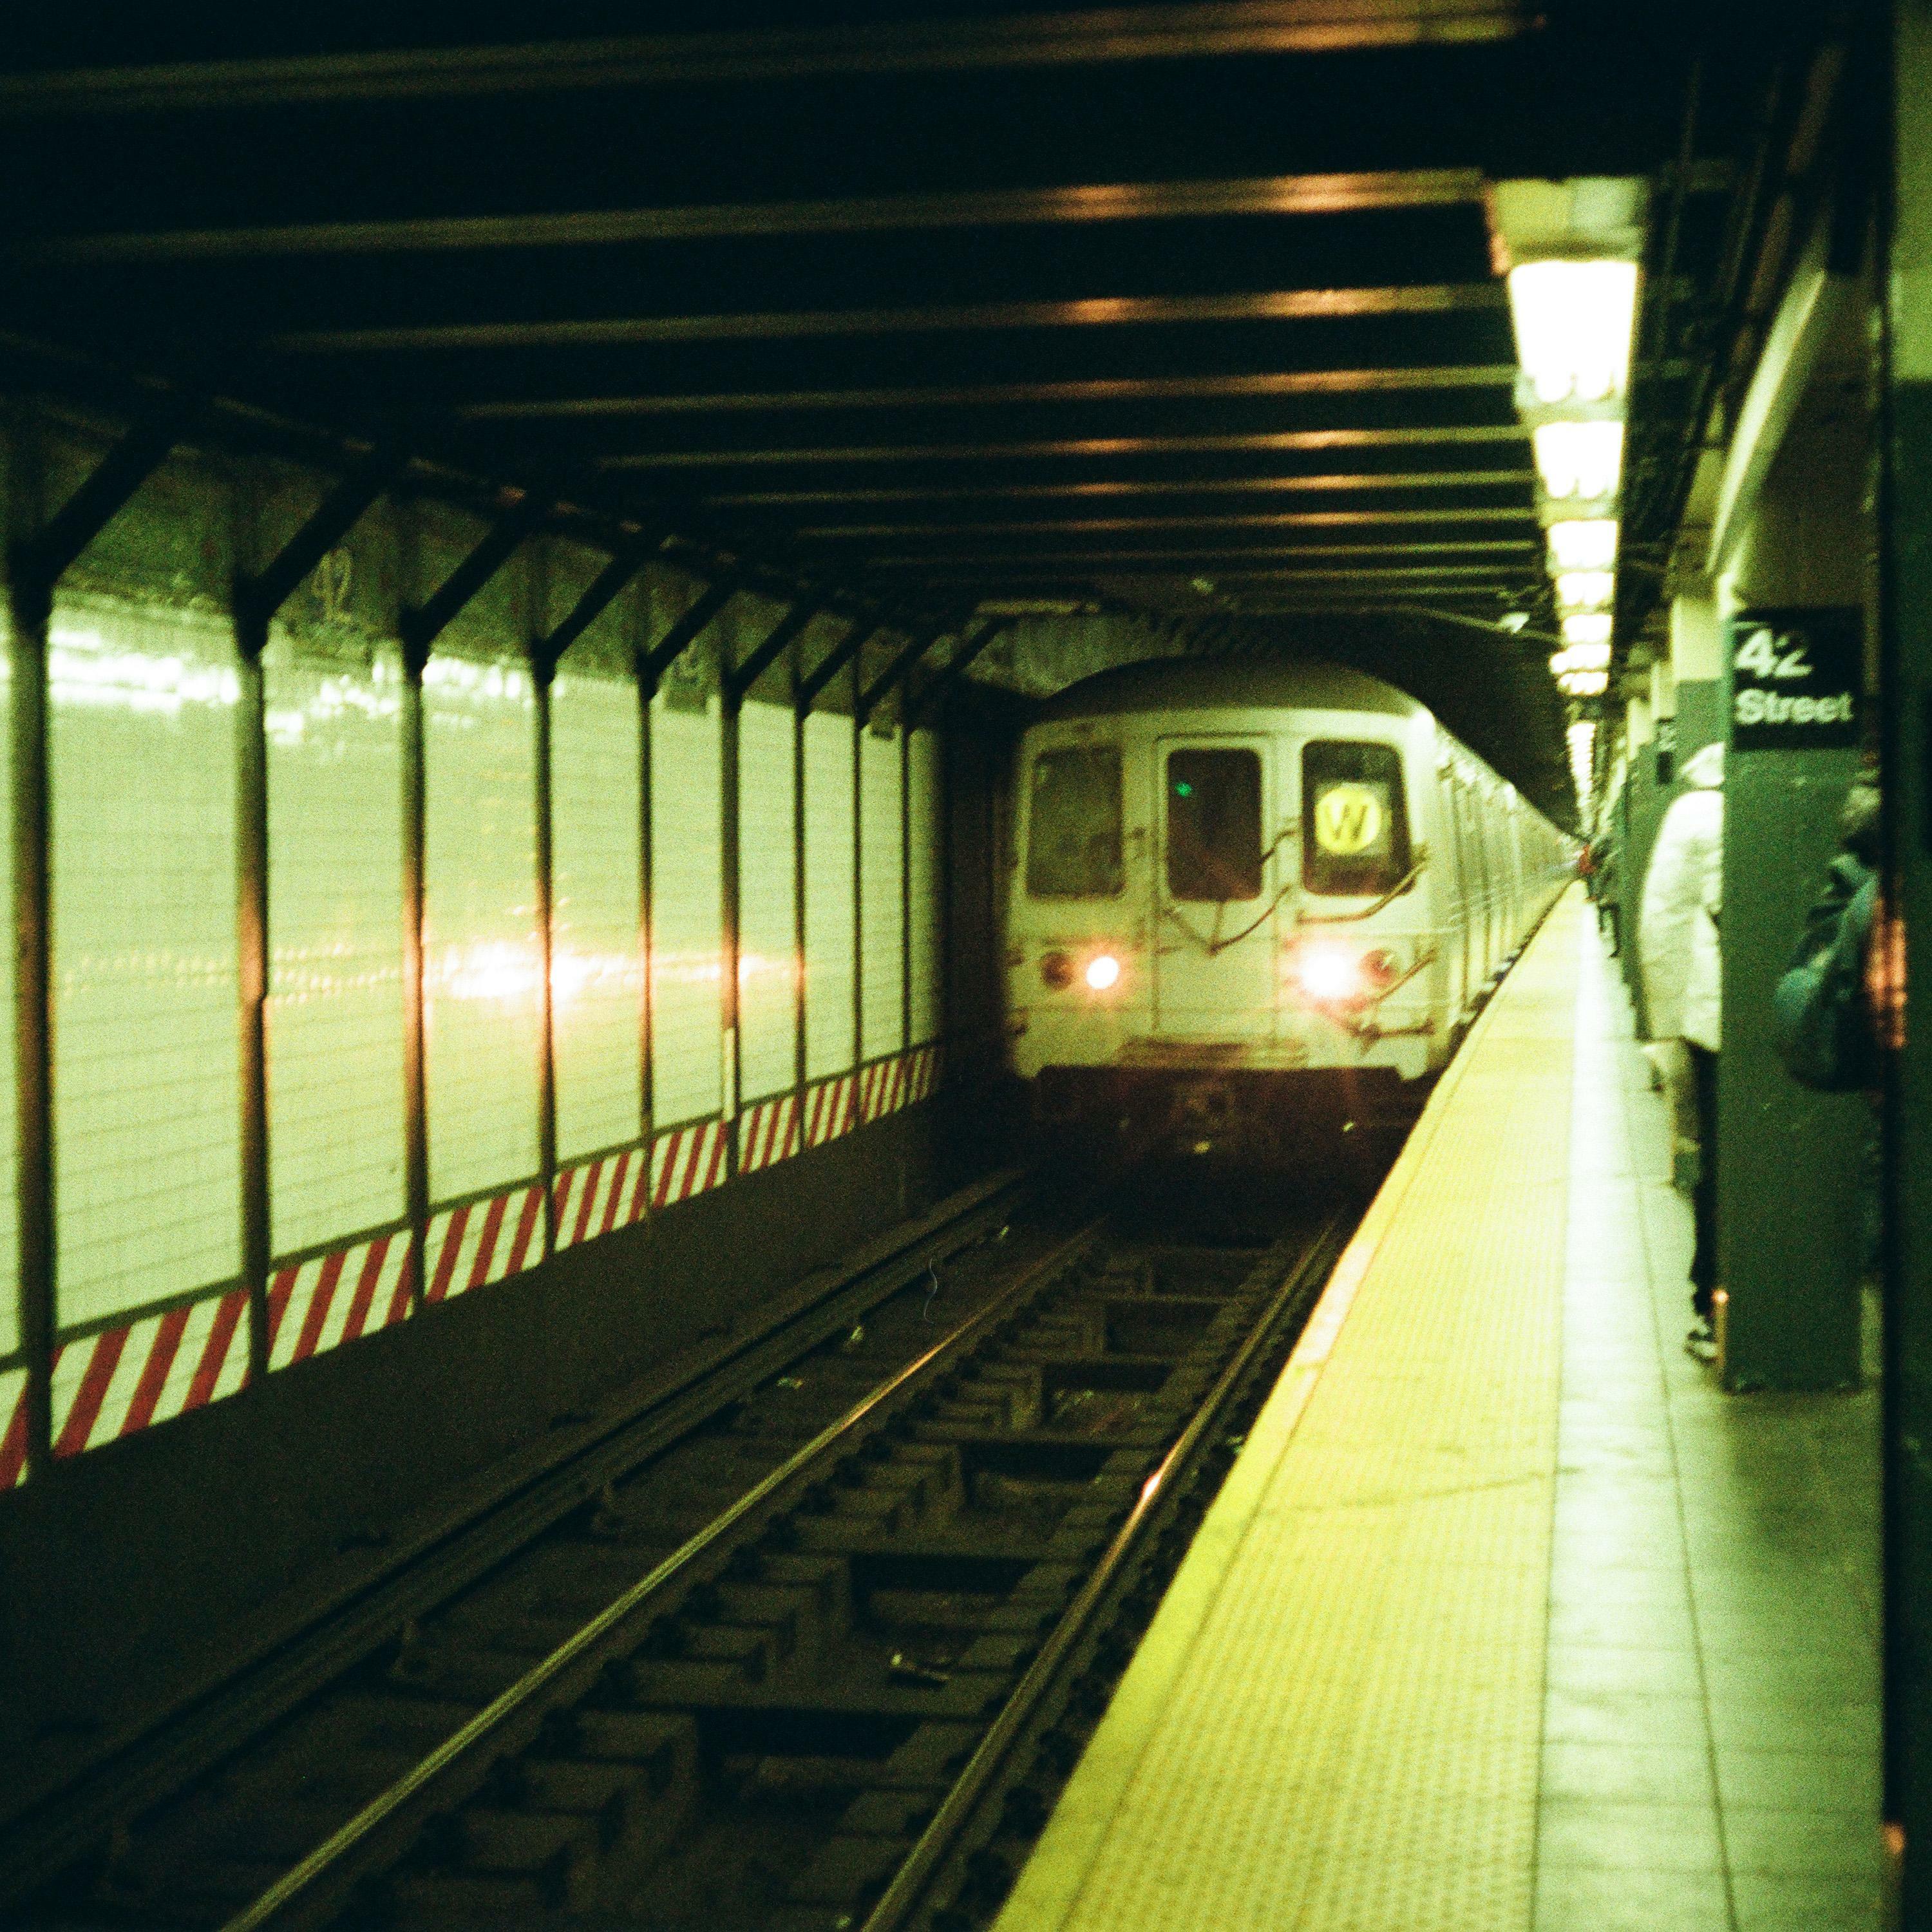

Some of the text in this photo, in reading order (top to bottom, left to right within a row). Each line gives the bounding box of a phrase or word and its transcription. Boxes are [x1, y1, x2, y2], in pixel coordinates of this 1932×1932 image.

[1734, 629, 1814, 678] 42
[1734, 689, 1854, 725] Street
[1323, 804, 1368, 842] W
